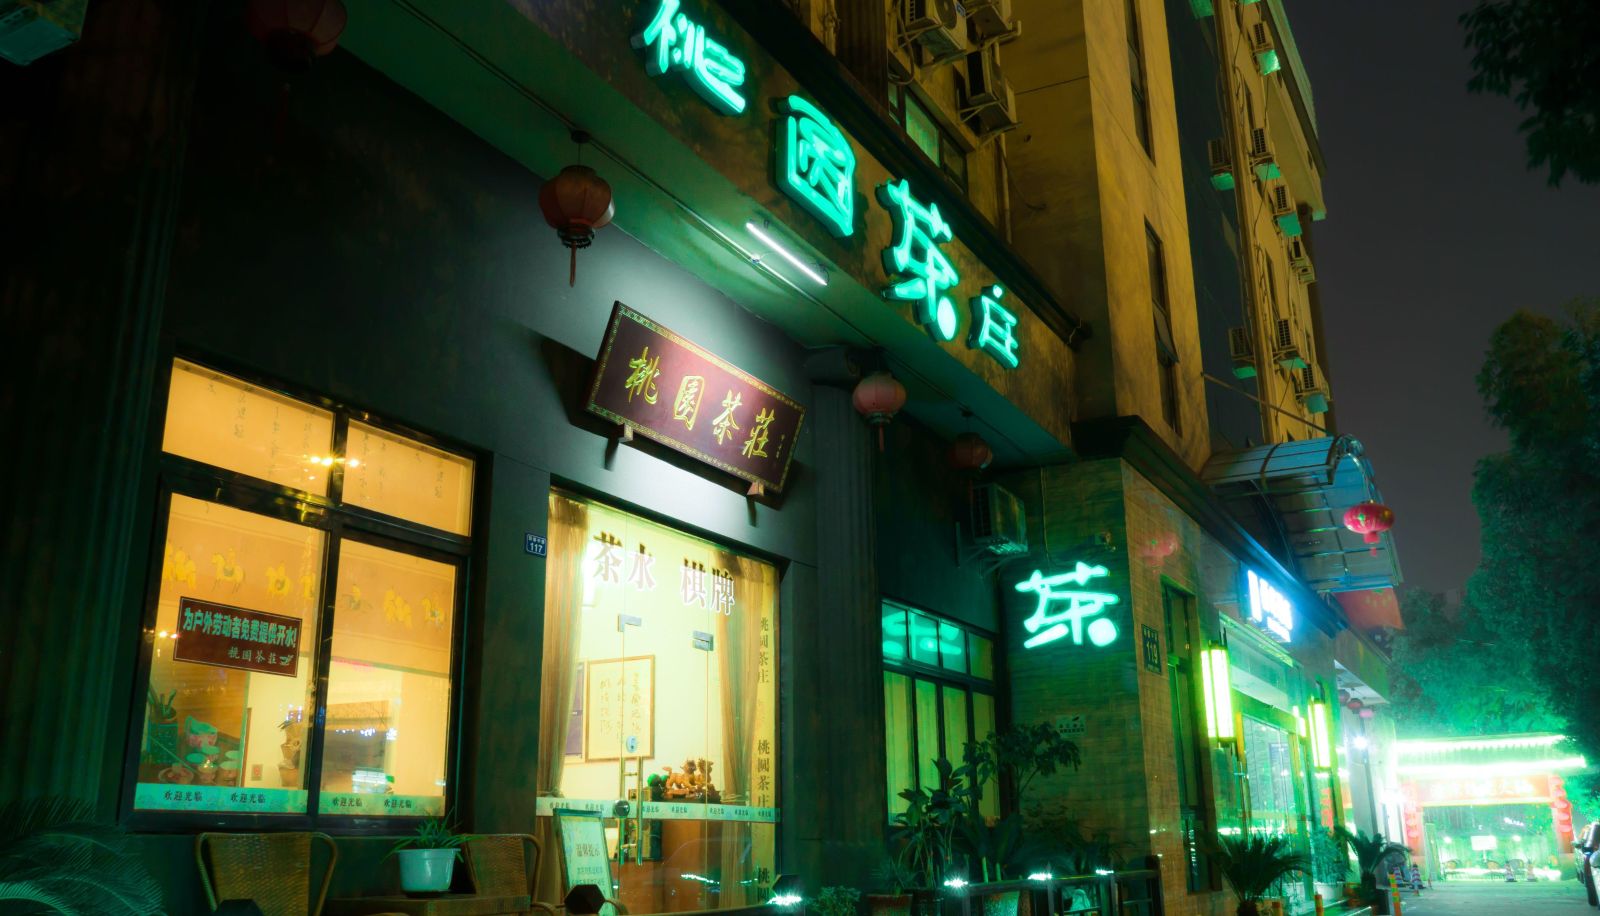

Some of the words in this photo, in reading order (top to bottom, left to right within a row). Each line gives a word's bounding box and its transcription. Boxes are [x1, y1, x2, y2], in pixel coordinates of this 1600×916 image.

[529, 542, 543, 553] 117
[592, 530, 657, 590] 茶水
[680, 558, 736, 616] 棋牌
[1013, 560, 1121, 649] 茶
